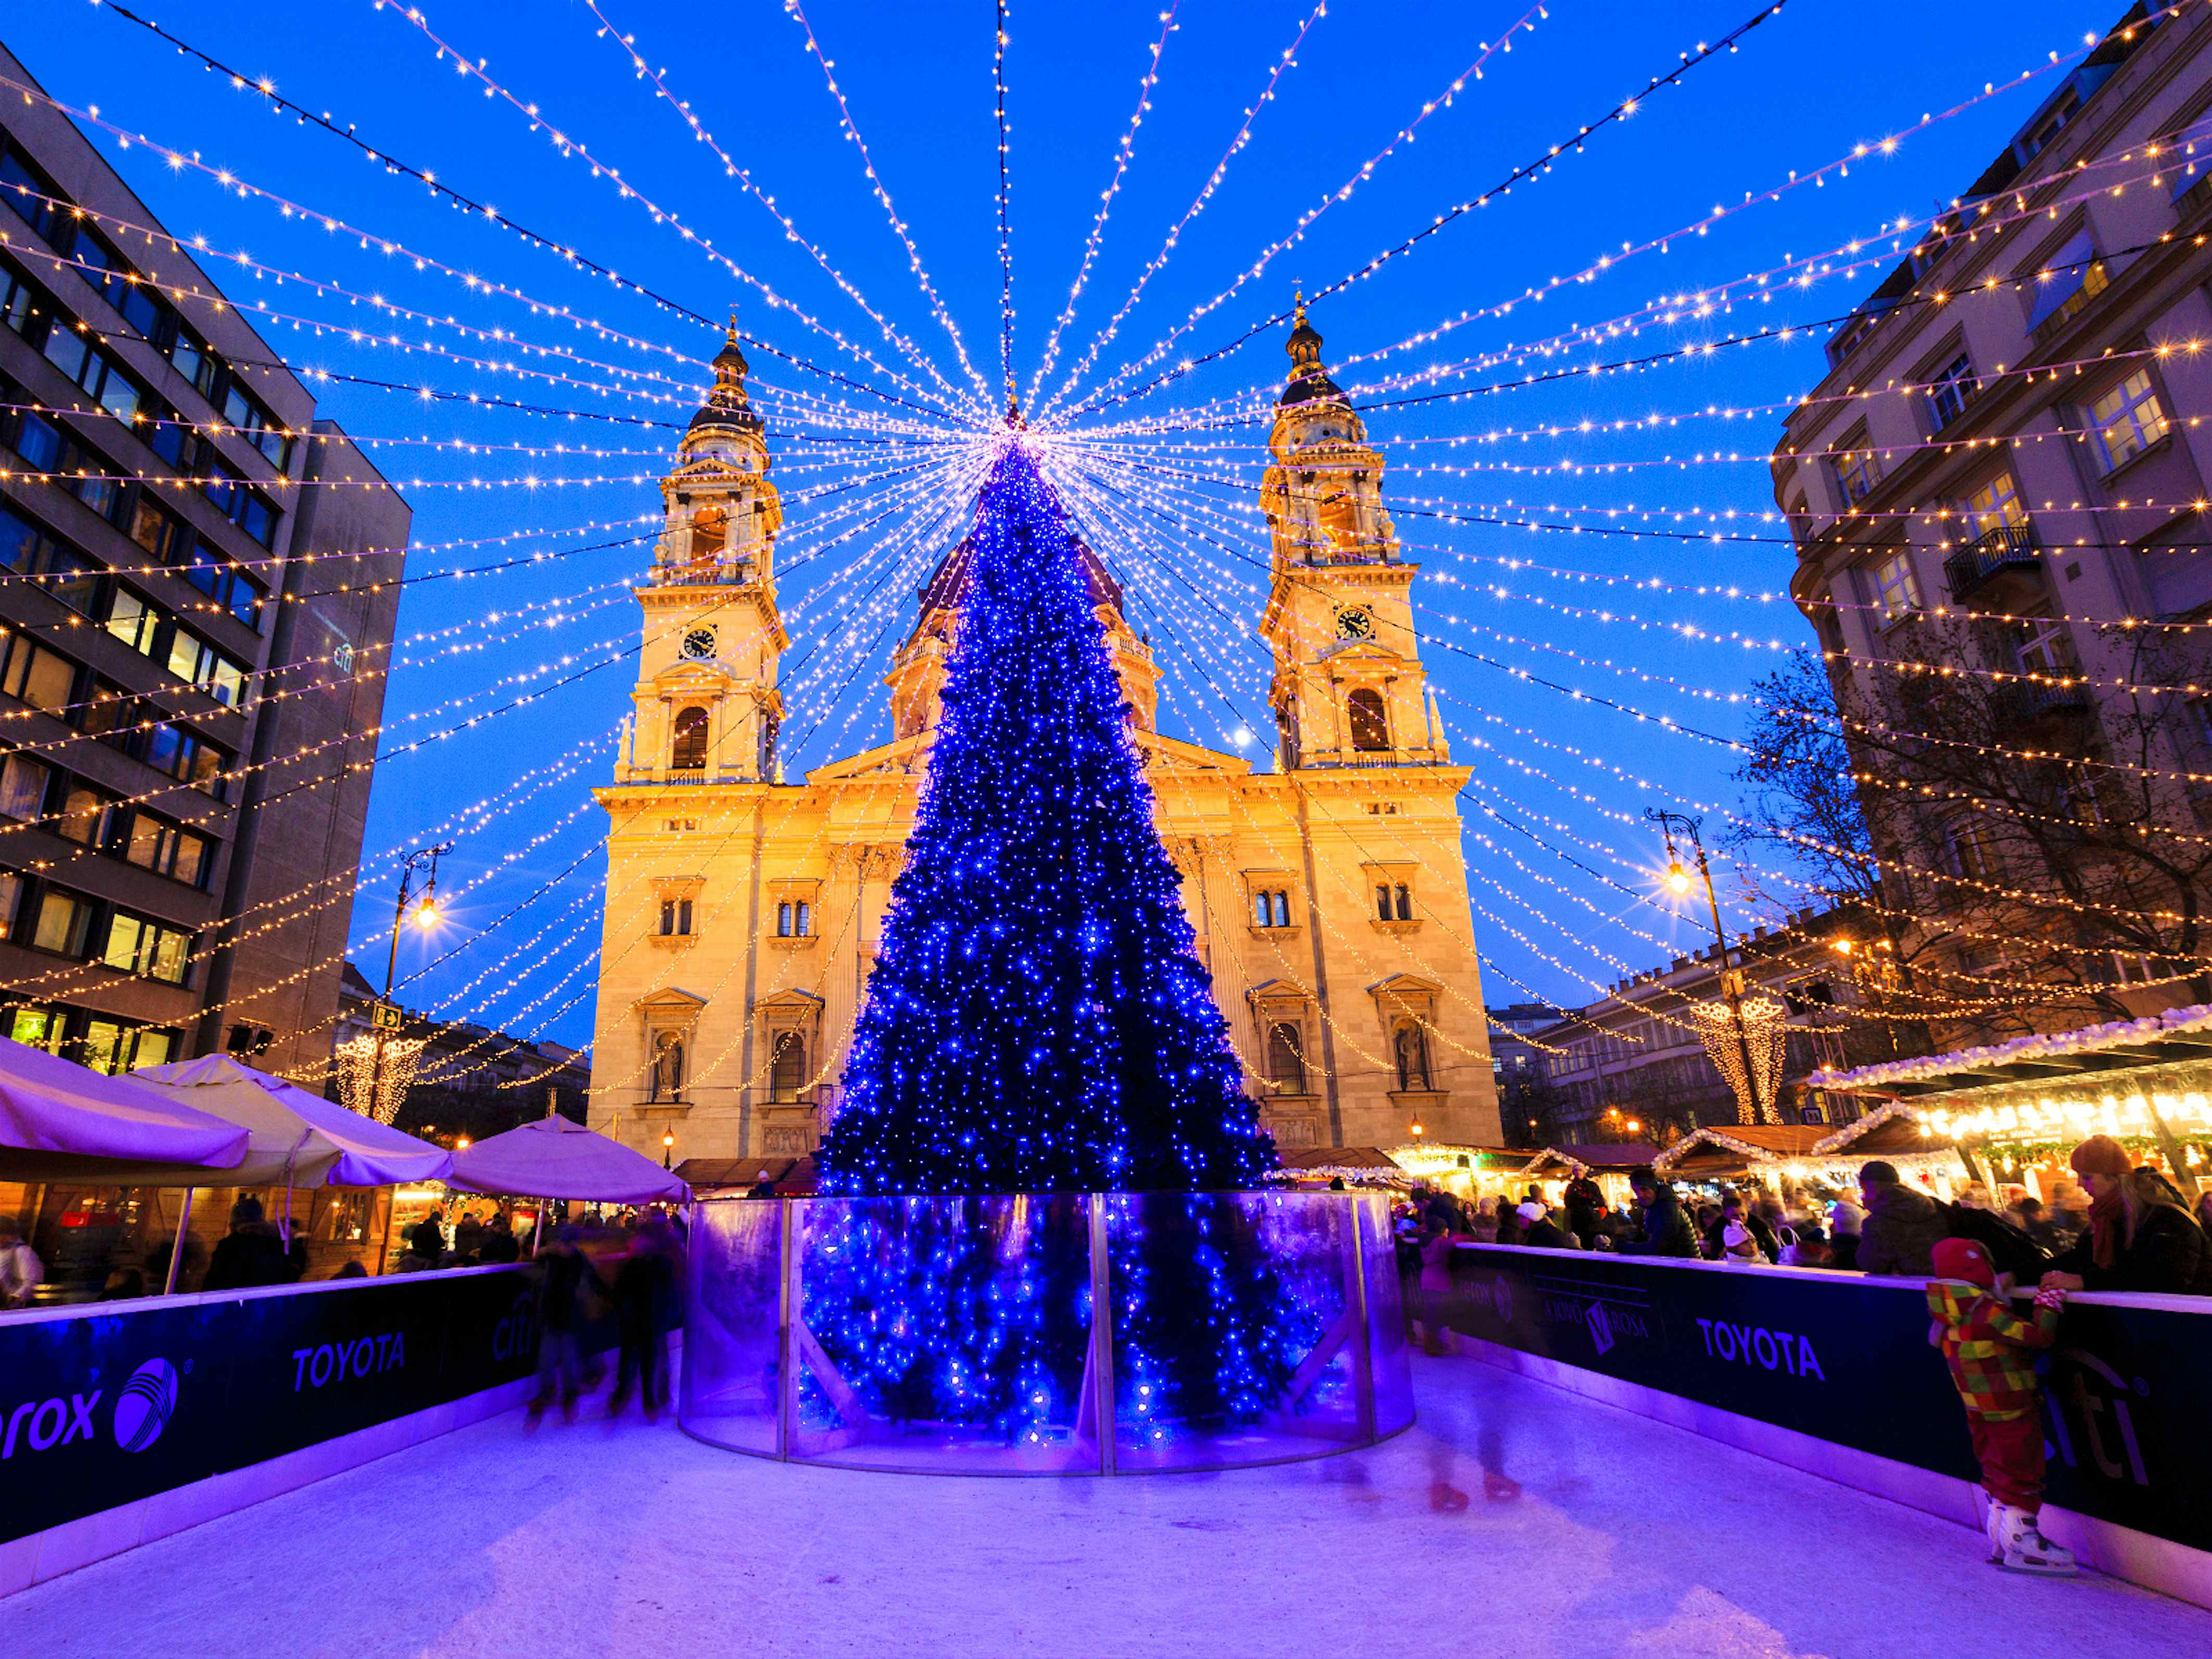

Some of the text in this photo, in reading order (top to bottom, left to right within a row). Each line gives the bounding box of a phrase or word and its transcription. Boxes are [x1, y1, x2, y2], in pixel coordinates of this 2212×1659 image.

[334, 643, 352, 674] citi
[293, 1332, 405, 1392] TOYOTA
[1695, 1318, 1826, 1382] TOYOTA
[0, 1388, 104, 1460] rox
[2034, 1348, 2150, 1486] iti
